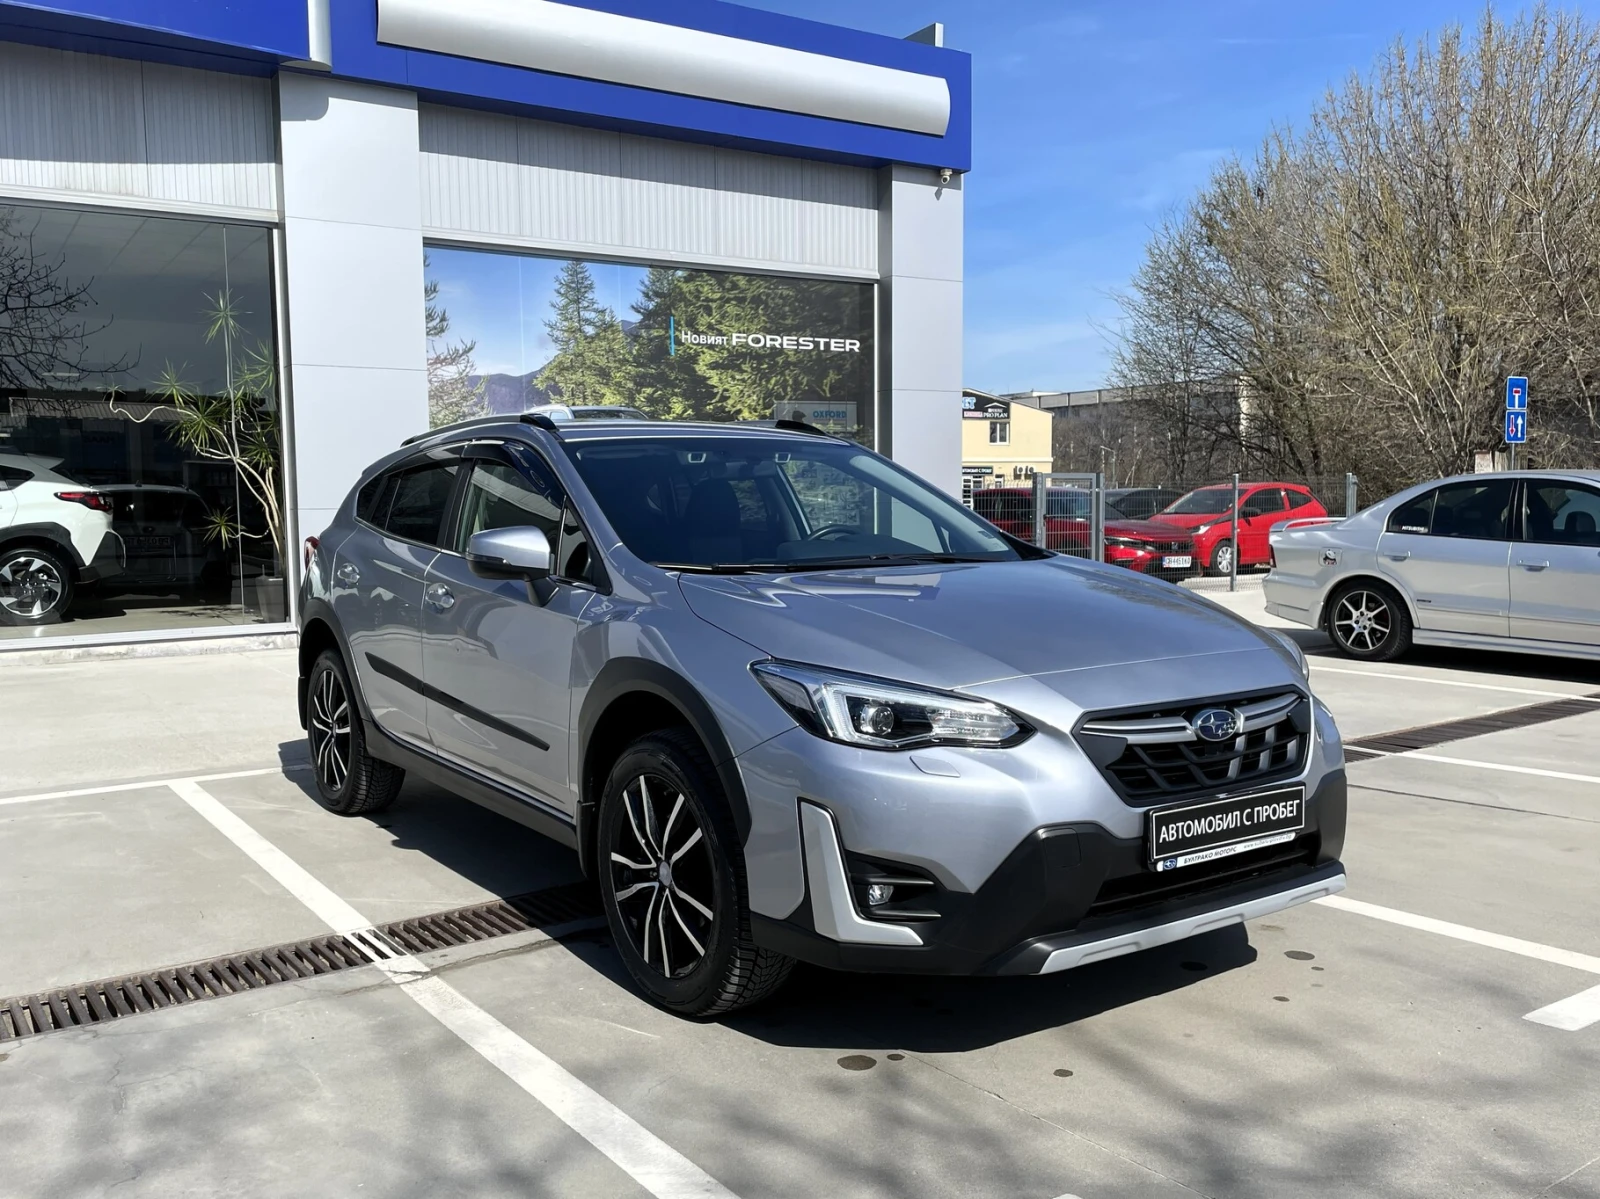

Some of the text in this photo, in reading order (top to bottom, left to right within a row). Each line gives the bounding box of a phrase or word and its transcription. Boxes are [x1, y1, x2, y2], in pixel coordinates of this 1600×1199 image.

[681, 330, 861, 353] Новият FORESTER
[812, 409, 847, 419] OXFORD
[1159, 799, 1300, 843] АВТОМОБИЛ С ПРОБЕГ
